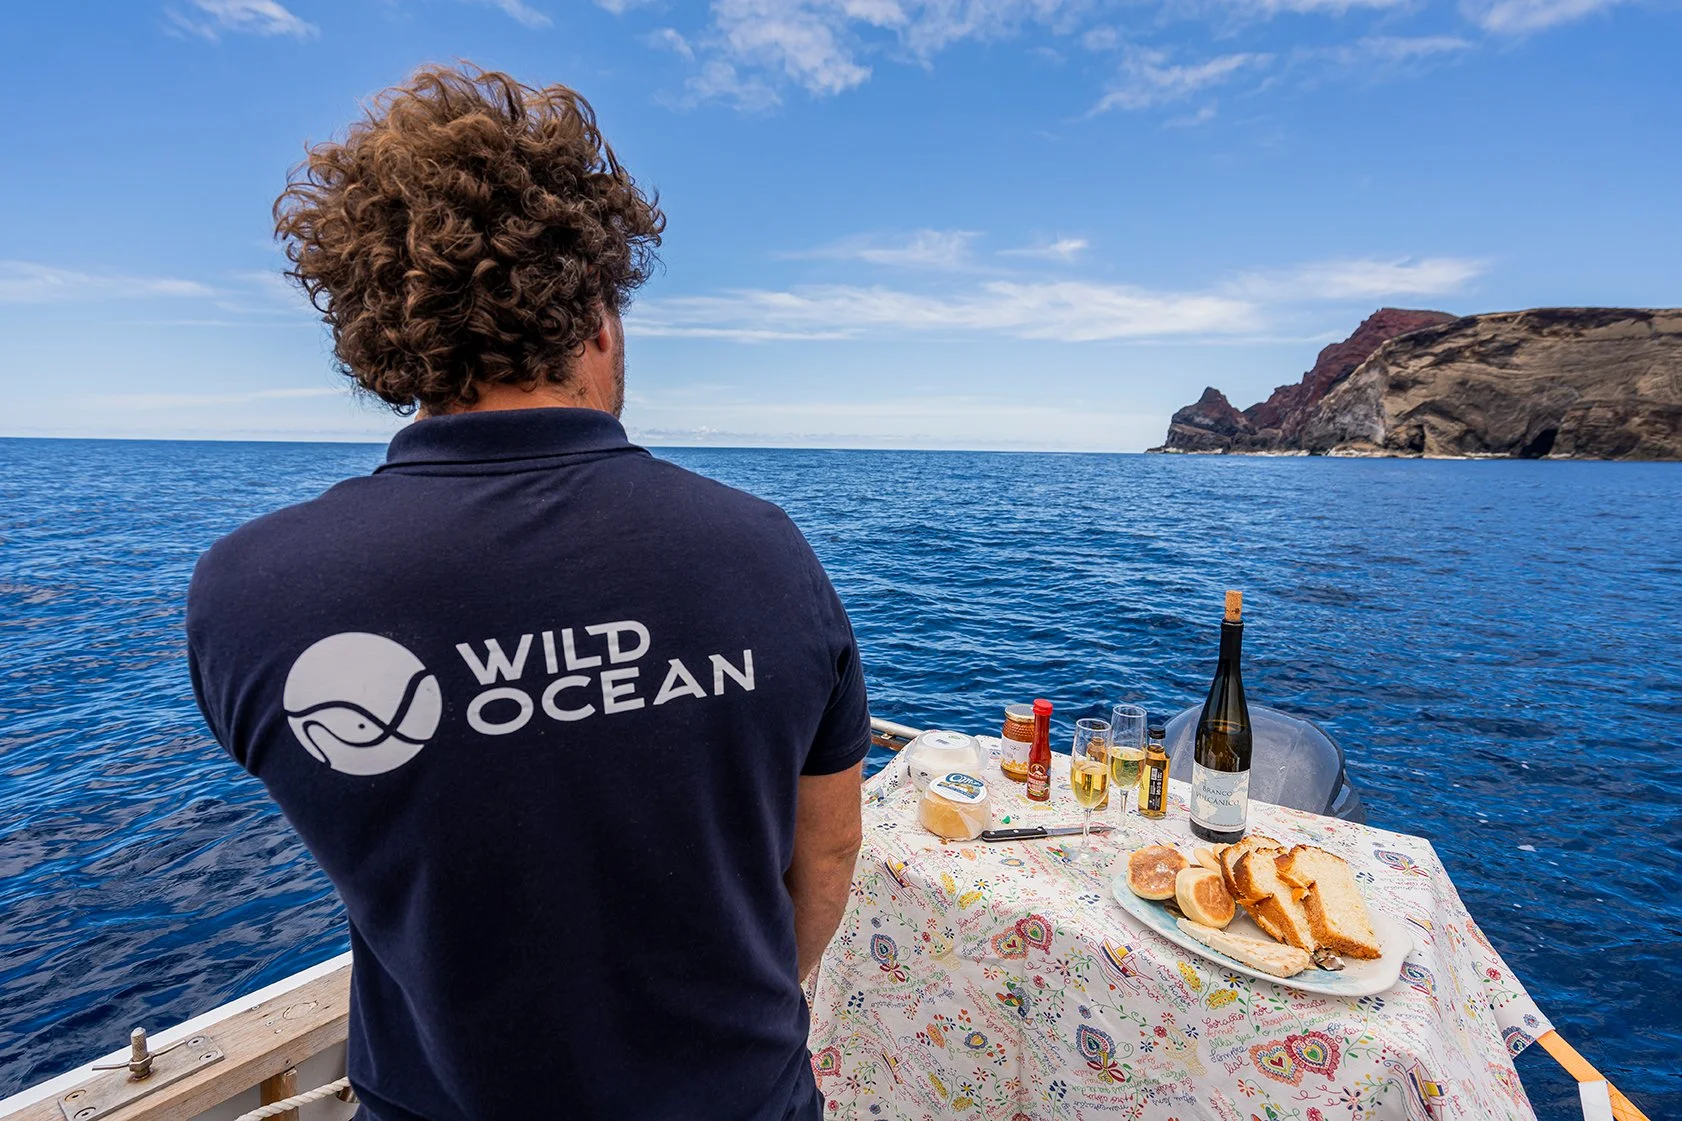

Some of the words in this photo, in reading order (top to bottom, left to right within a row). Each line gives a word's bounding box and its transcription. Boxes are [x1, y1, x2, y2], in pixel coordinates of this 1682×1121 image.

[455, 620, 651, 686] WILD
[466, 649, 755, 736] OCEAN
[1202, 785, 1233, 797] BRANCO
